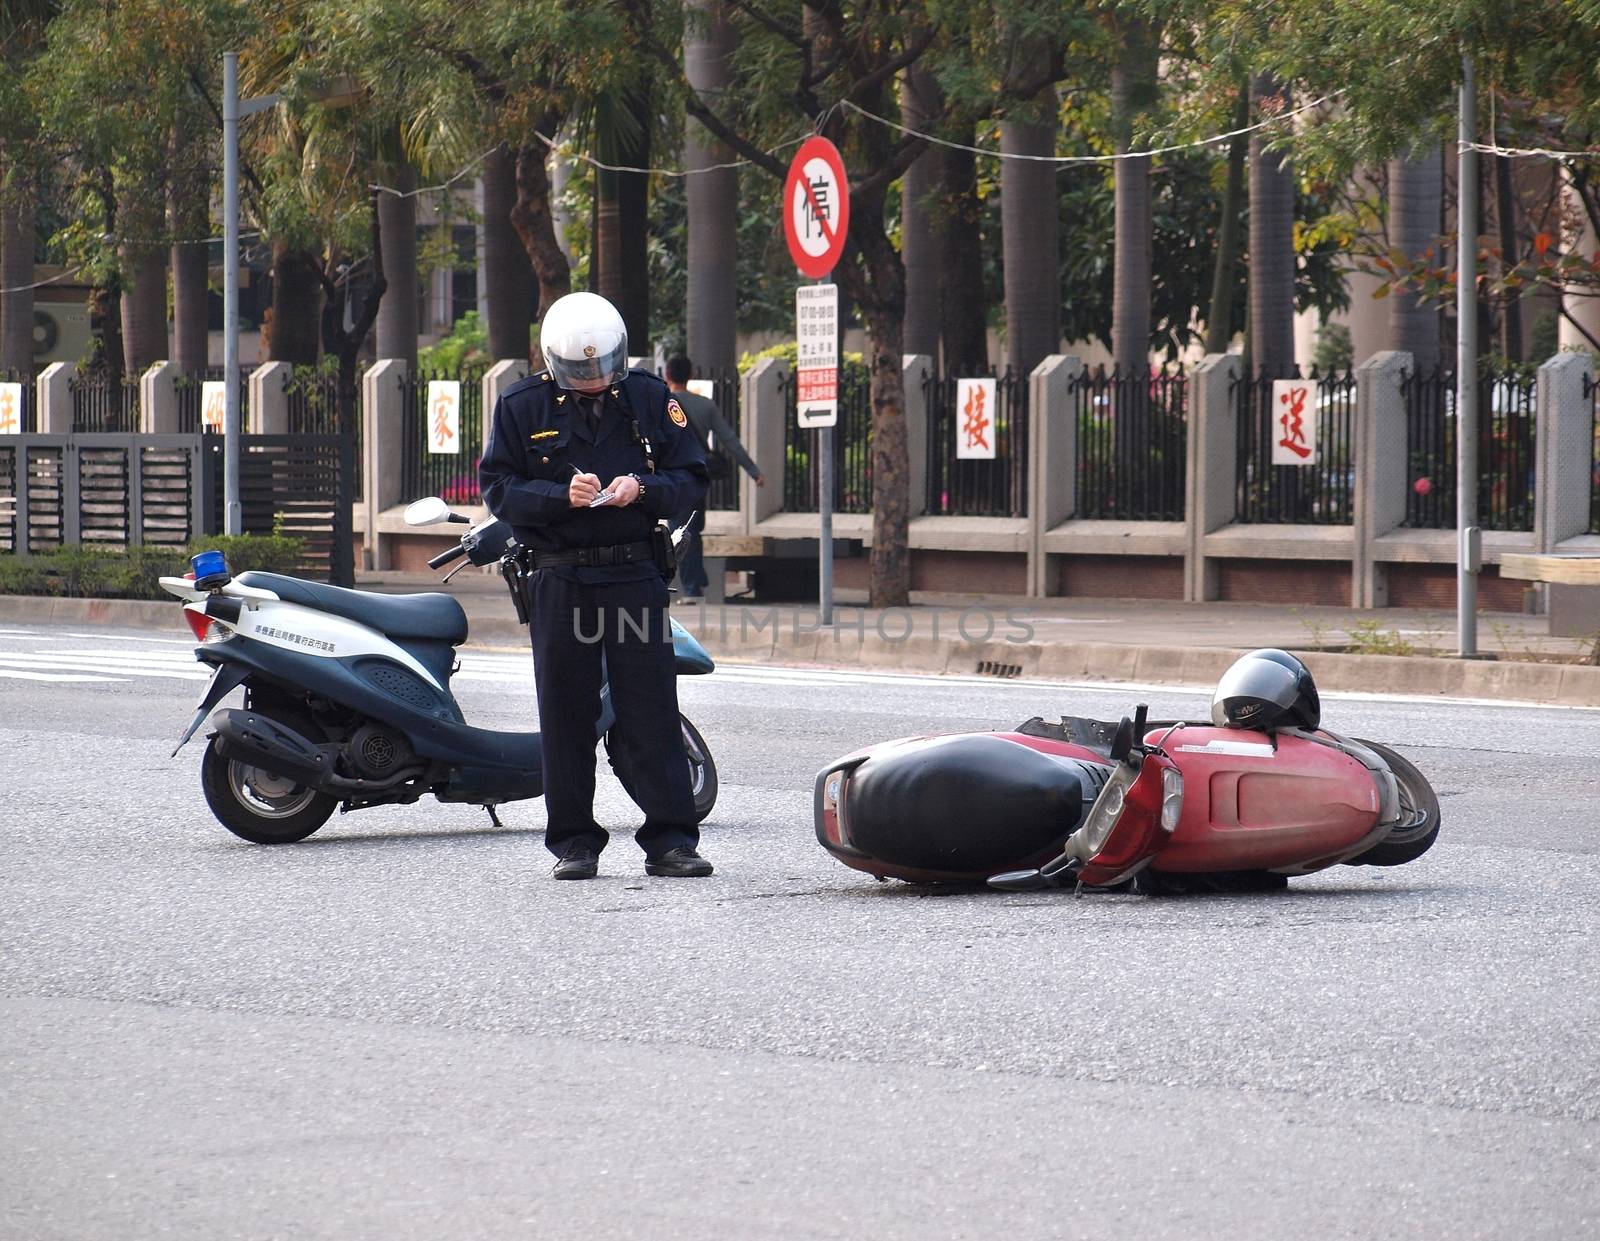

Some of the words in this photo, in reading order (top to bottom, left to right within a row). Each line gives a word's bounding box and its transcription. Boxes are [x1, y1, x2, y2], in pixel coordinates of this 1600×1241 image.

[802, 175, 830, 239] 停
[432, 389, 454, 447] 家
[964, 385, 989, 450] 接
[1279, 387, 1312, 458] 送
